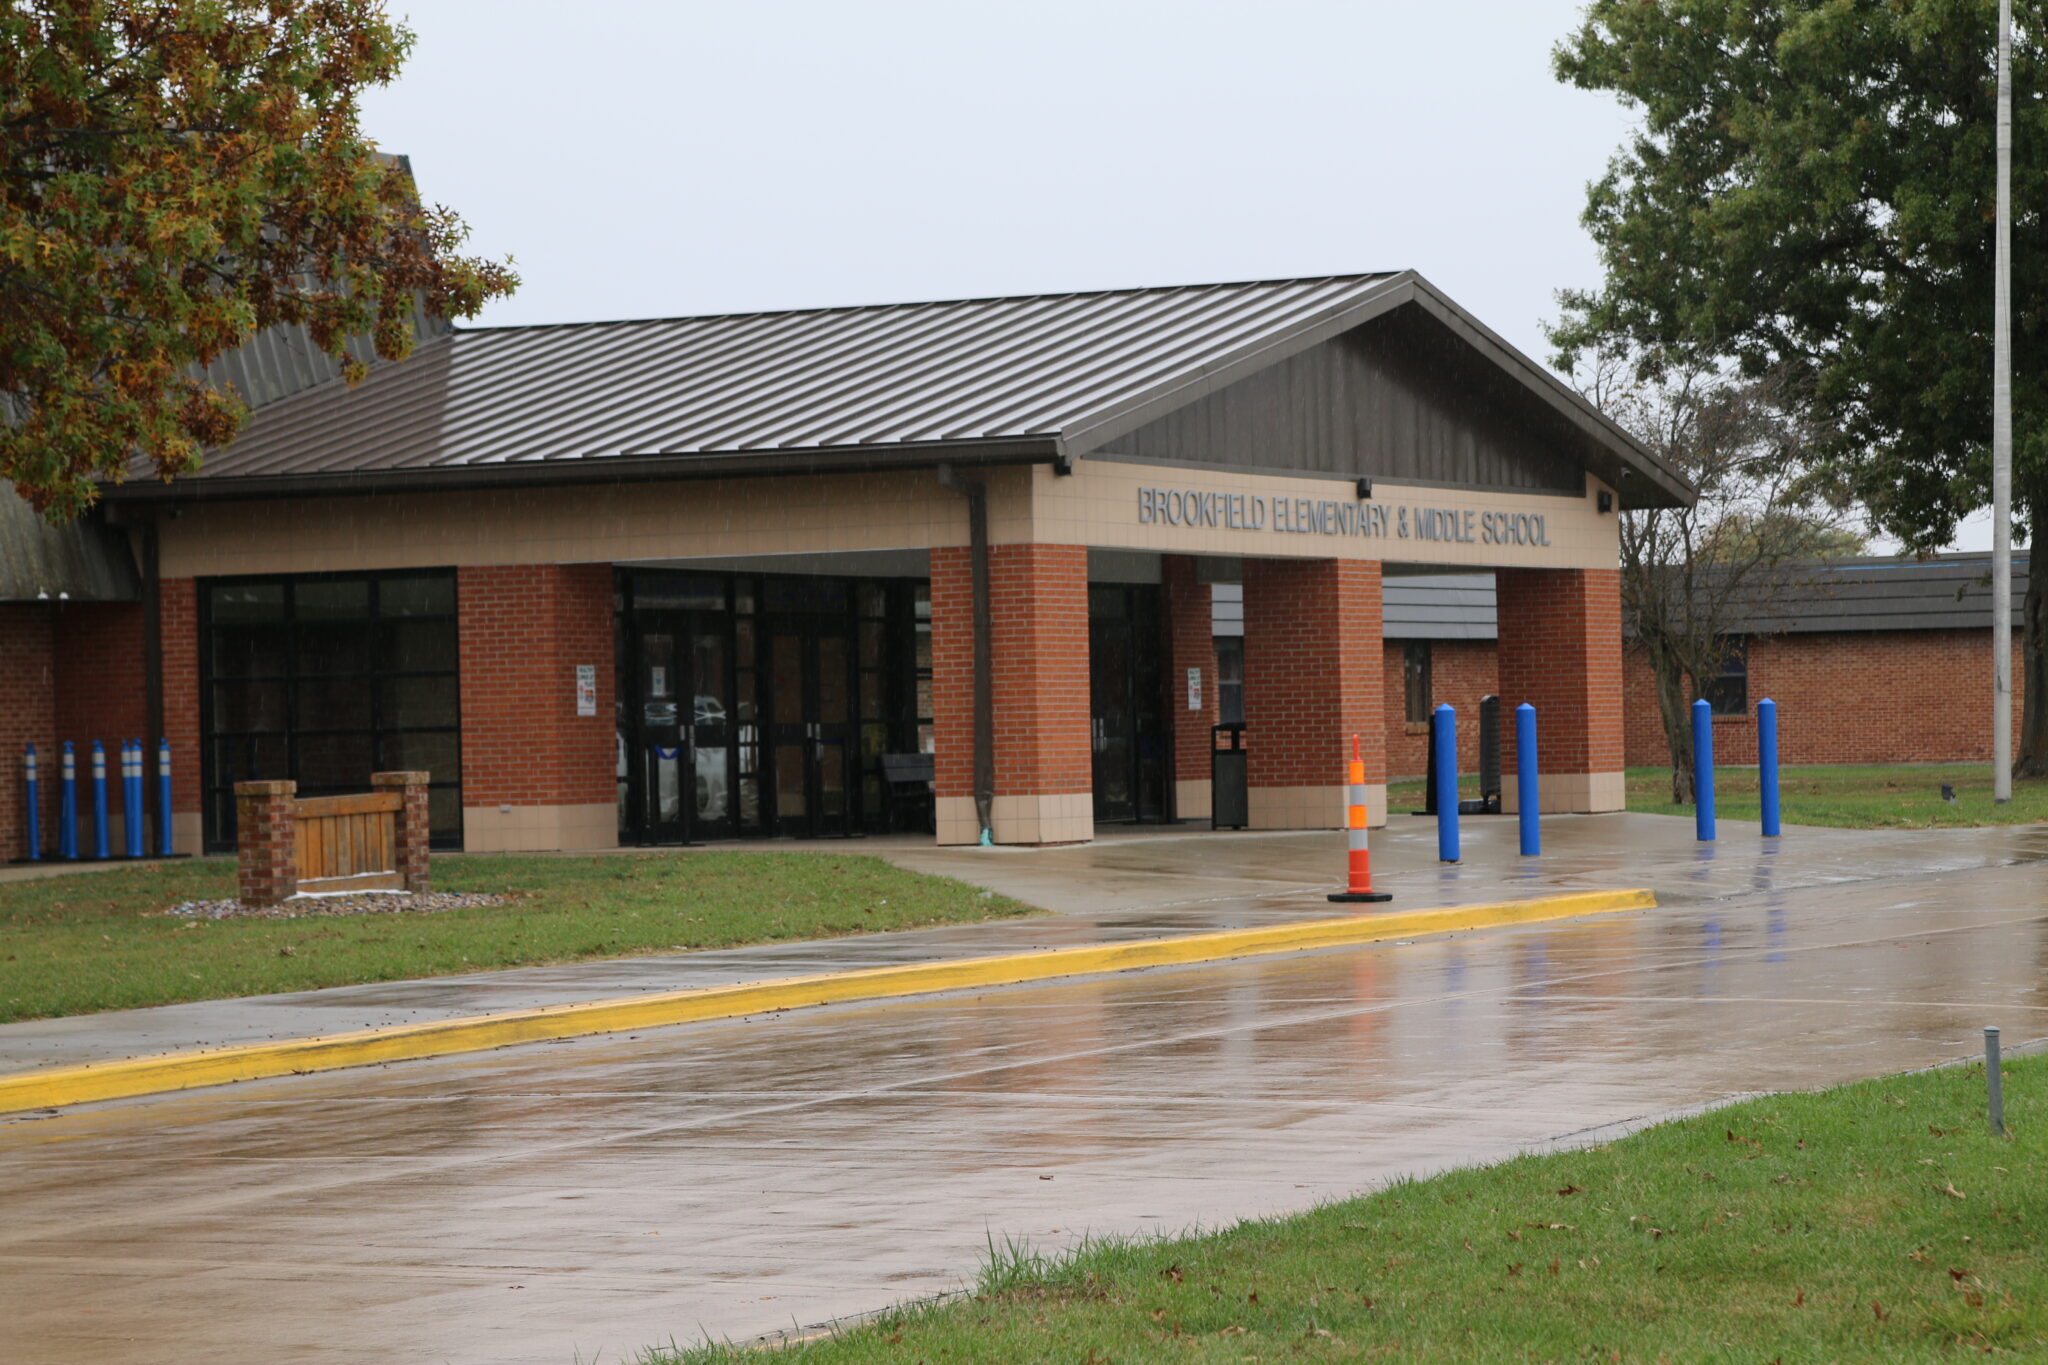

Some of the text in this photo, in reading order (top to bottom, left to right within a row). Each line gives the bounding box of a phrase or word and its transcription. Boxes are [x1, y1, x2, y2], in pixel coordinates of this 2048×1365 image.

[1138, 487, 1550, 547] BROOKFIELD ELEMENTARY & MIDDLE SCHOOL
